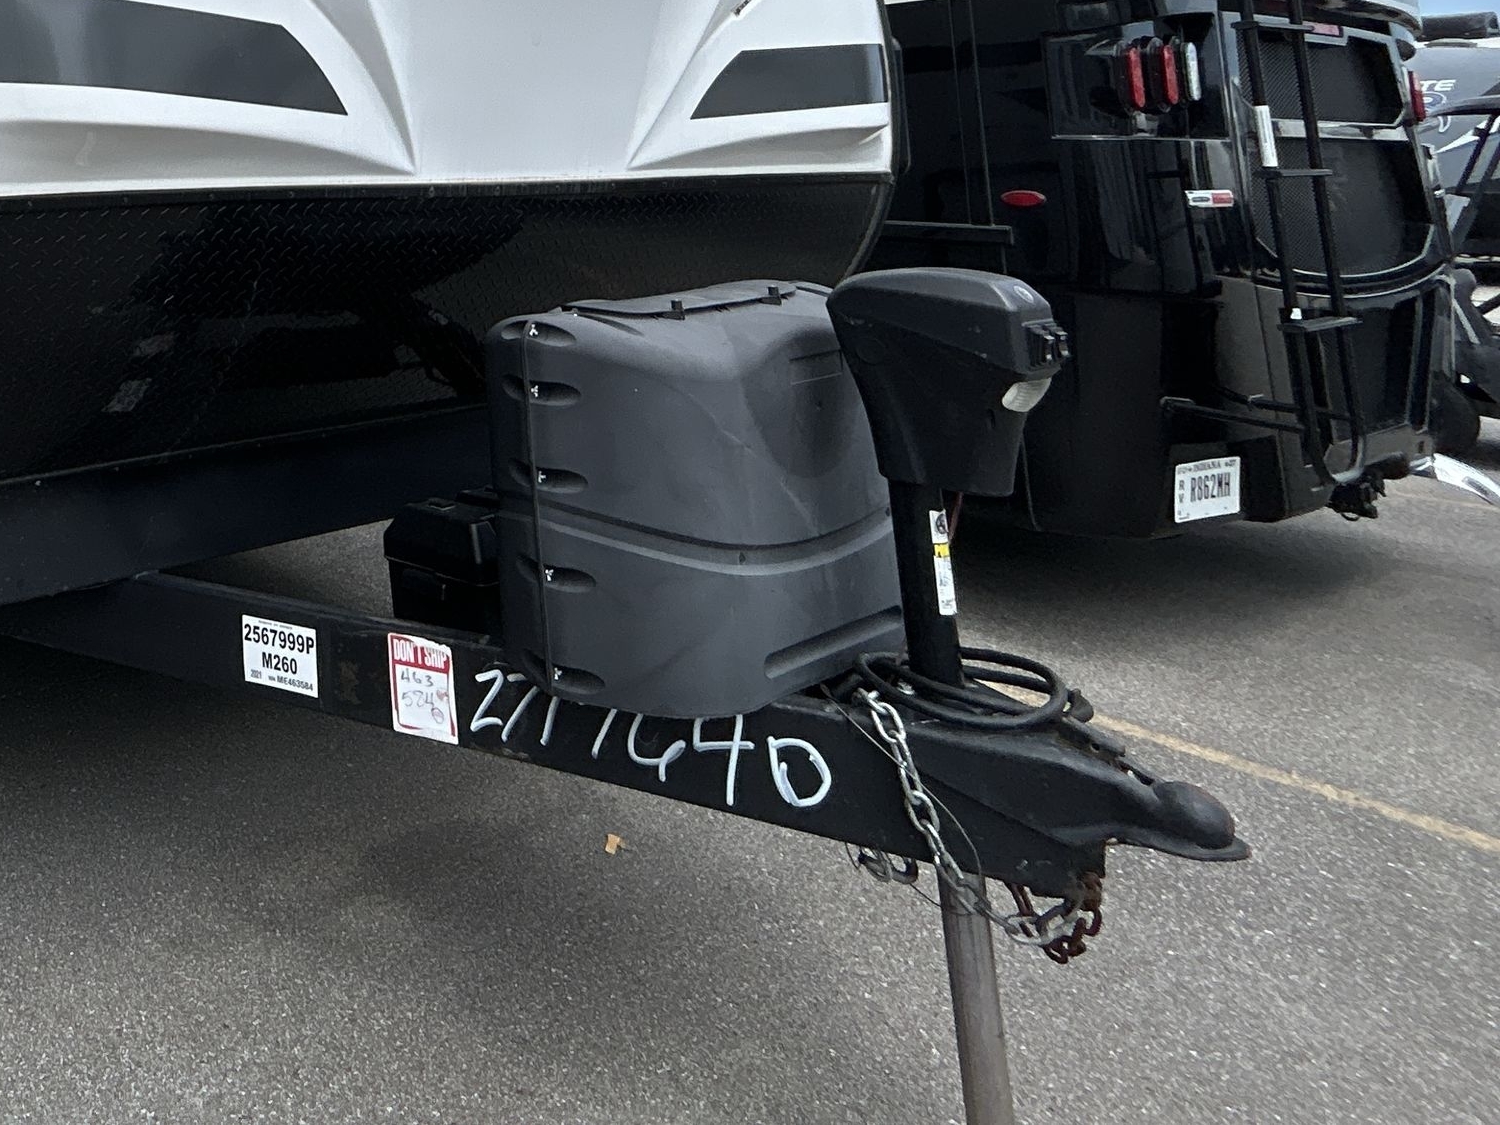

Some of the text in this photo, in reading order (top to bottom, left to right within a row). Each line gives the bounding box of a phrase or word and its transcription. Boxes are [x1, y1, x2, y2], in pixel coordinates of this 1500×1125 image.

[244, 623, 315, 655] 2567999P
[262, 651, 298, 675] M260
[424, 646, 447, 670] SHIP
[250, 669, 262, 679] 2021
[401, 668, 434, 688] 463
